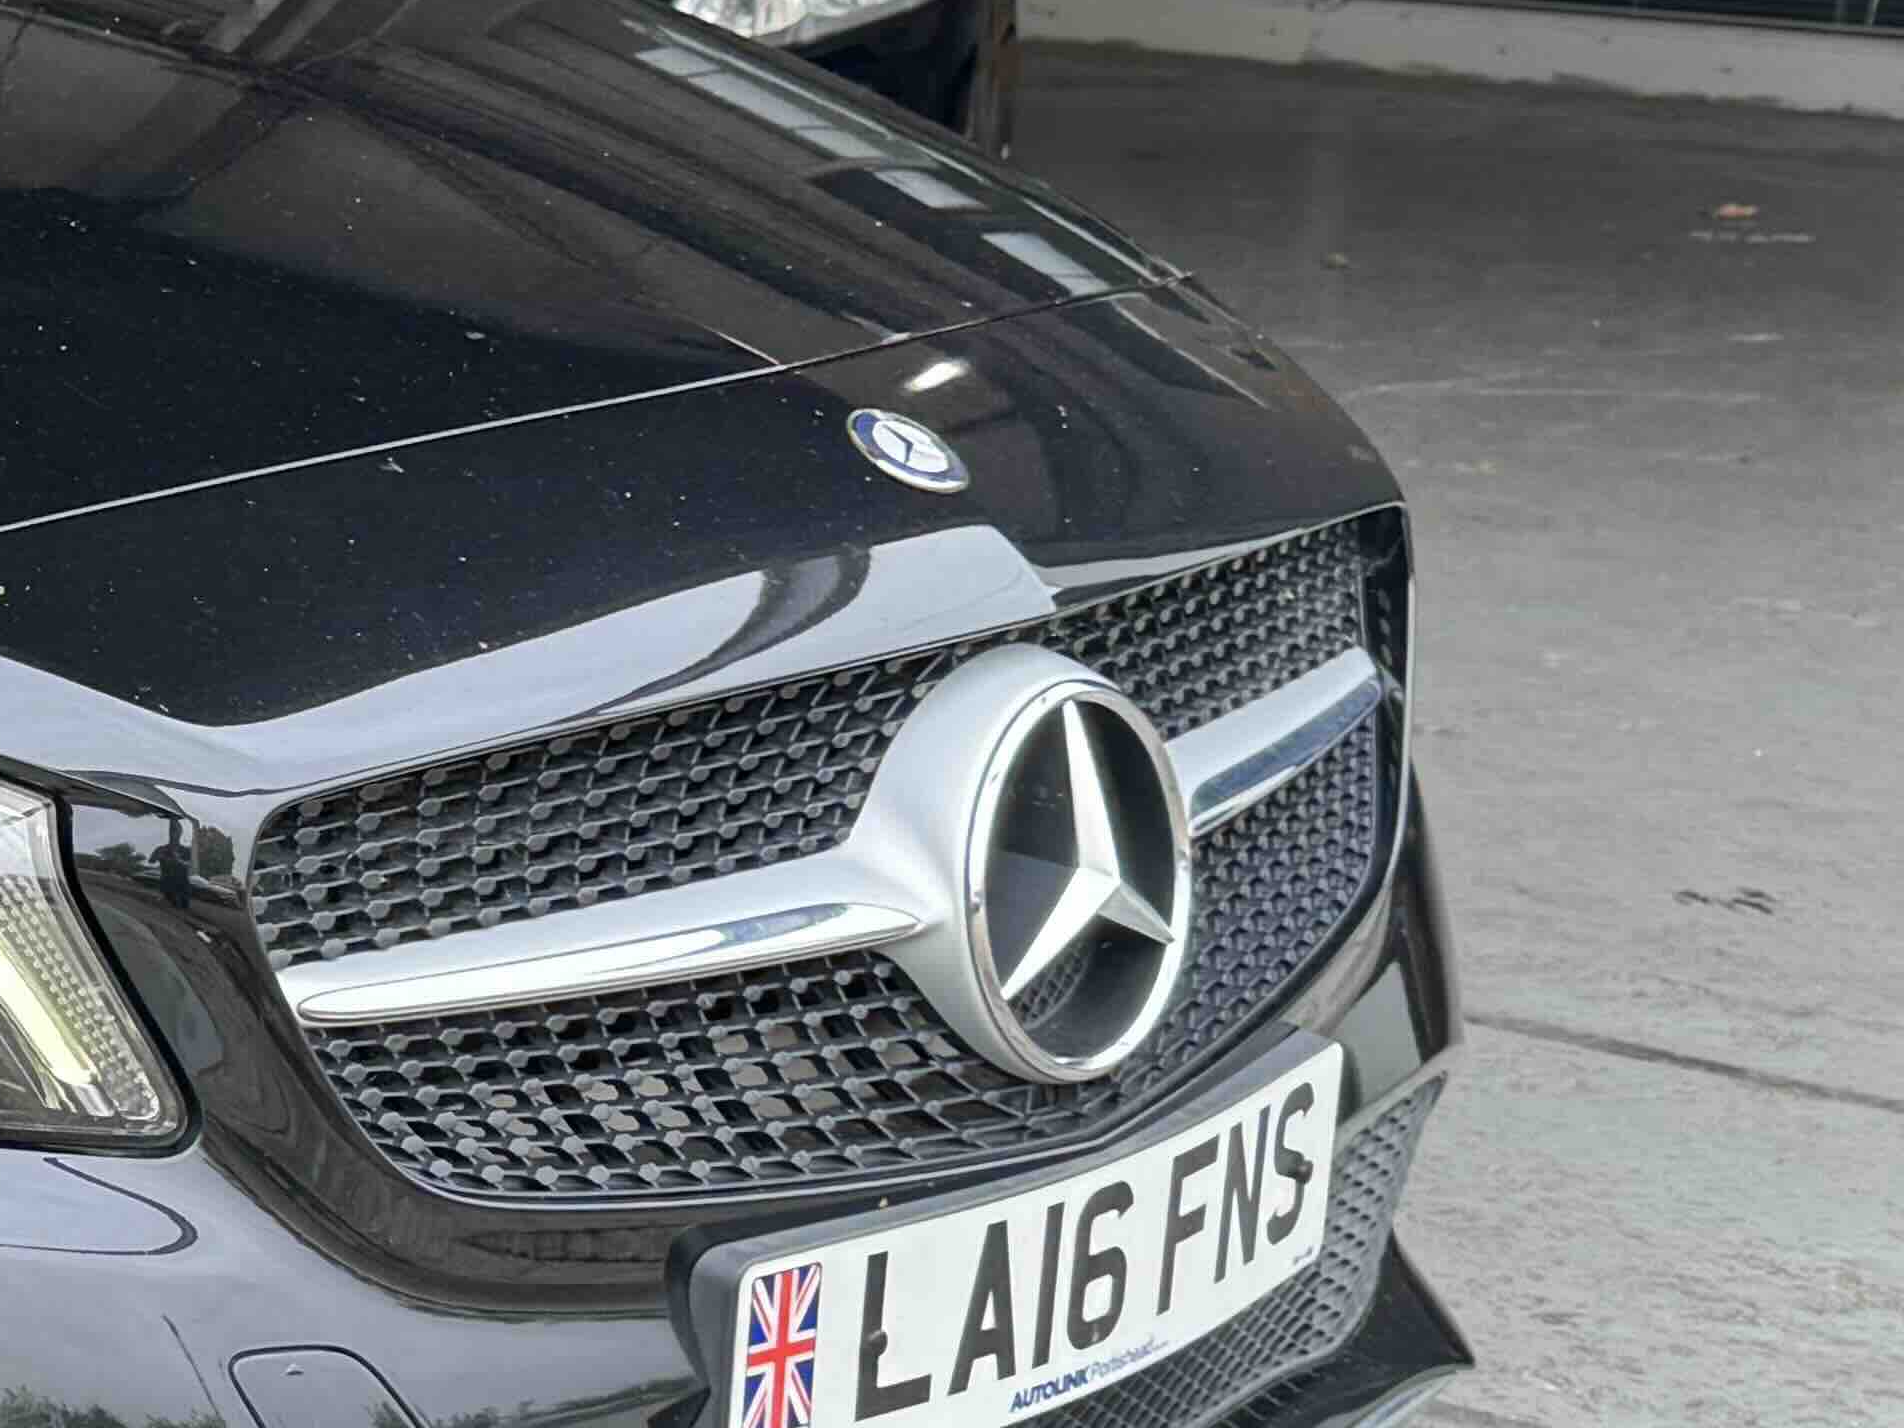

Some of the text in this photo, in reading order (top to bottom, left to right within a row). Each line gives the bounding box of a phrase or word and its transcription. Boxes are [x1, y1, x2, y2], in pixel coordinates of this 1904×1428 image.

[856, 1082, 1315, 1421] LA16 FNS
[1010, 1369, 1088, 1412] AUTOLINK
